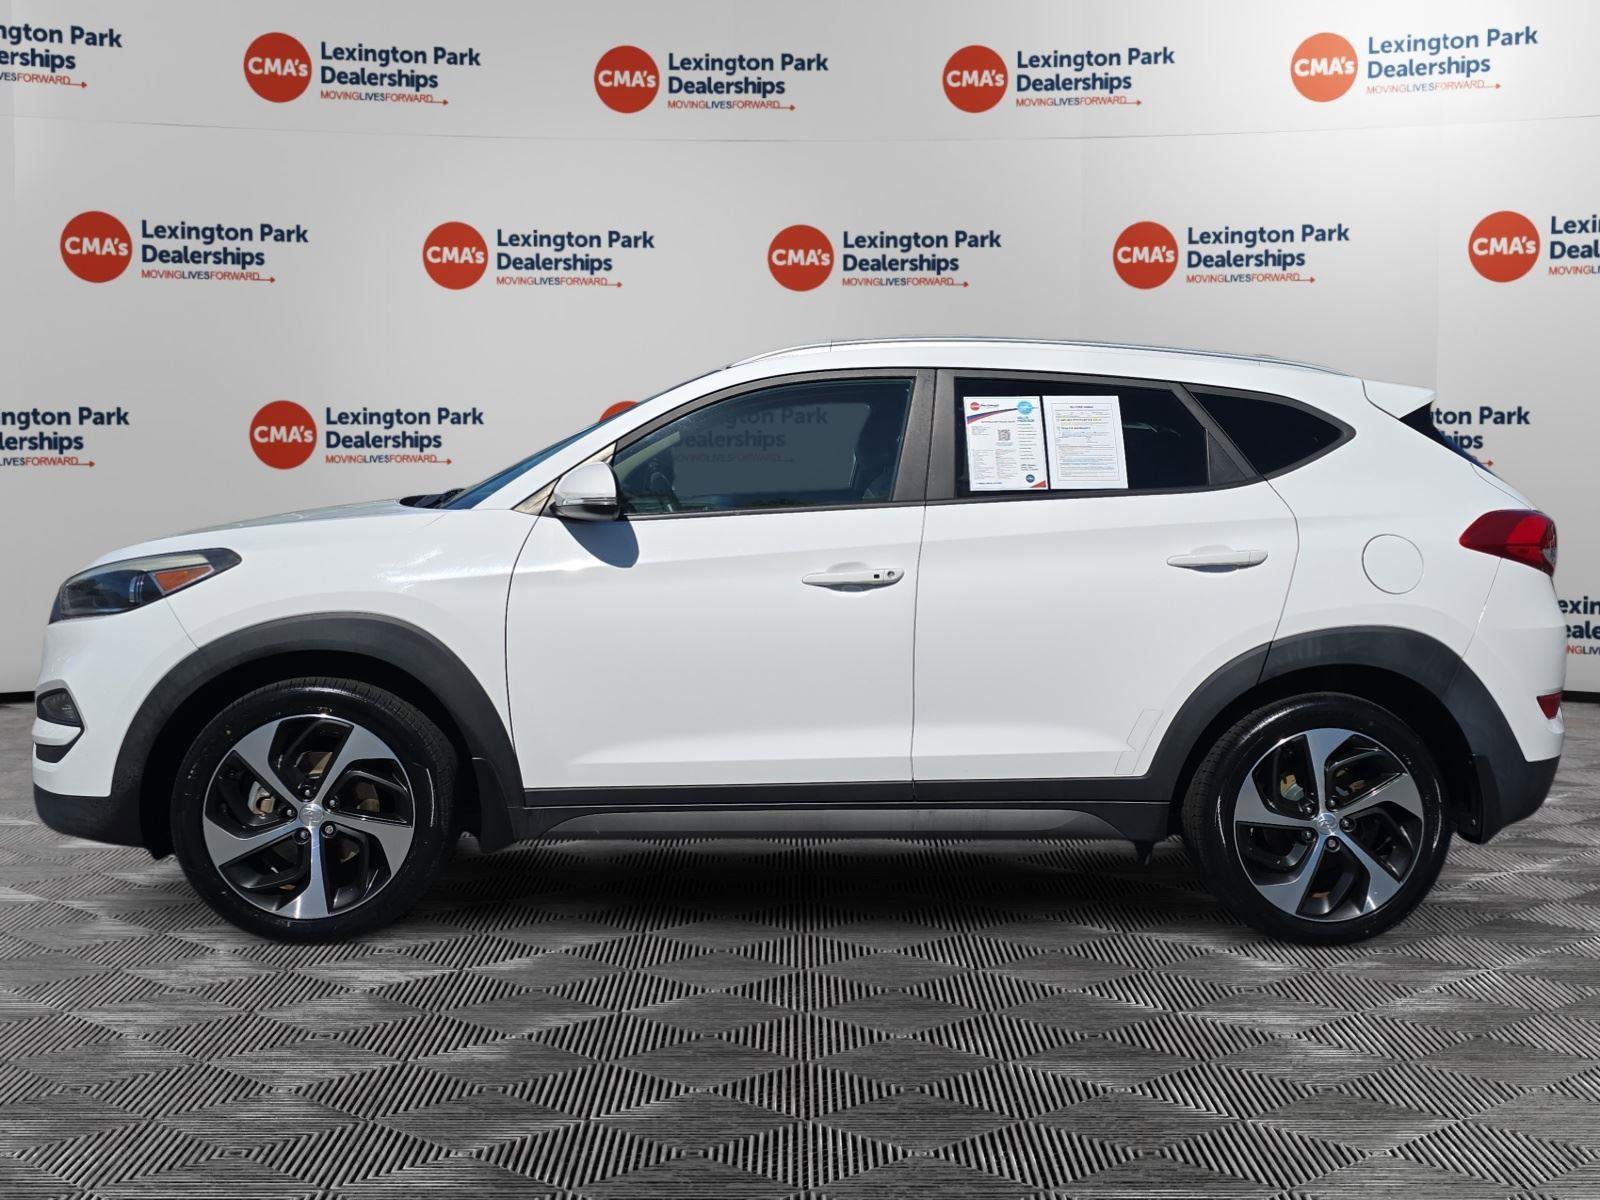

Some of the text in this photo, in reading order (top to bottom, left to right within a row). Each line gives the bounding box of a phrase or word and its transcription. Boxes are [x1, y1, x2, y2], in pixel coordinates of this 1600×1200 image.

[71, 26, 122, 47] Park
[1369, 26, 1537, 55] Lexington Park
[321, 42, 480, 68] Lexington Park
[669, 53, 828, 75] Lexington Park
[1018, 47, 1174, 74] Lexington Park
[249, 58, 307, 76] CMA's
[1294, 56, 1355, 76] CMA's
[1368, 56, 1490, 78] Dealerships
[321, 67, 438, 92] Dealerships
[599, 71, 655, 87] CMA's
[669, 76, 785, 98] Dealerships
[947, 70, 1004, 87] CMA's
[1017, 73, 1131, 94] Dealerships
[1367, 80, 1484, 94] MOVINGLIVESFORWARD
[321, 89, 433, 103] MOVINGLIVESFORWARD
[668, 100, 780, 109] MOVINGLIVESFORWARD
[1016, 96, 1130, 107] MOVINGLIVESFORWARD
[142, 220, 308, 246] Lexington Park
[1550, 214, 1600, 235] Lexi
[65, 237, 128, 255] CMA's
[498, 229, 654, 252] Lexington Park
[844, 230, 1001, 253] Lexington Park
[1188, 224, 1349, 248] Lexington Park
[1473, 236, 1536, 255] CMA's
[142, 244, 265, 269] Dealerships
[427, 247, 484, 263] CMA's
[497, 253, 612, 275] Dealerships
[772, 249, 830, 265] CMA's
[843, 254, 959, 275] Dealerships
[1118, 246, 1174, 263] CMA's
[1188, 250, 1305, 271] Dealerships
[141, 269, 260, 281] MOVINGLIVESFORWARD
[496, 276, 608, 286] MOVINGLIVESFORWARD
[842, 277, 954, 286] MOVINGLIVESFORWARD
[1186, 273, 1300, 283] MOVINGLIVESFORWARD
[2, 407, 129, 430] ngton Park
[326, 407, 483, 429] Lexington Park
[781, 407, 828, 425] Park
[1431, 406, 1530, 425] ton Park
[254, 427, 312, 442] CMA's
[326, 431, 441, 452] Dealerships
[325, 455, 437, 463] MOVINGLIVESFORWARD
